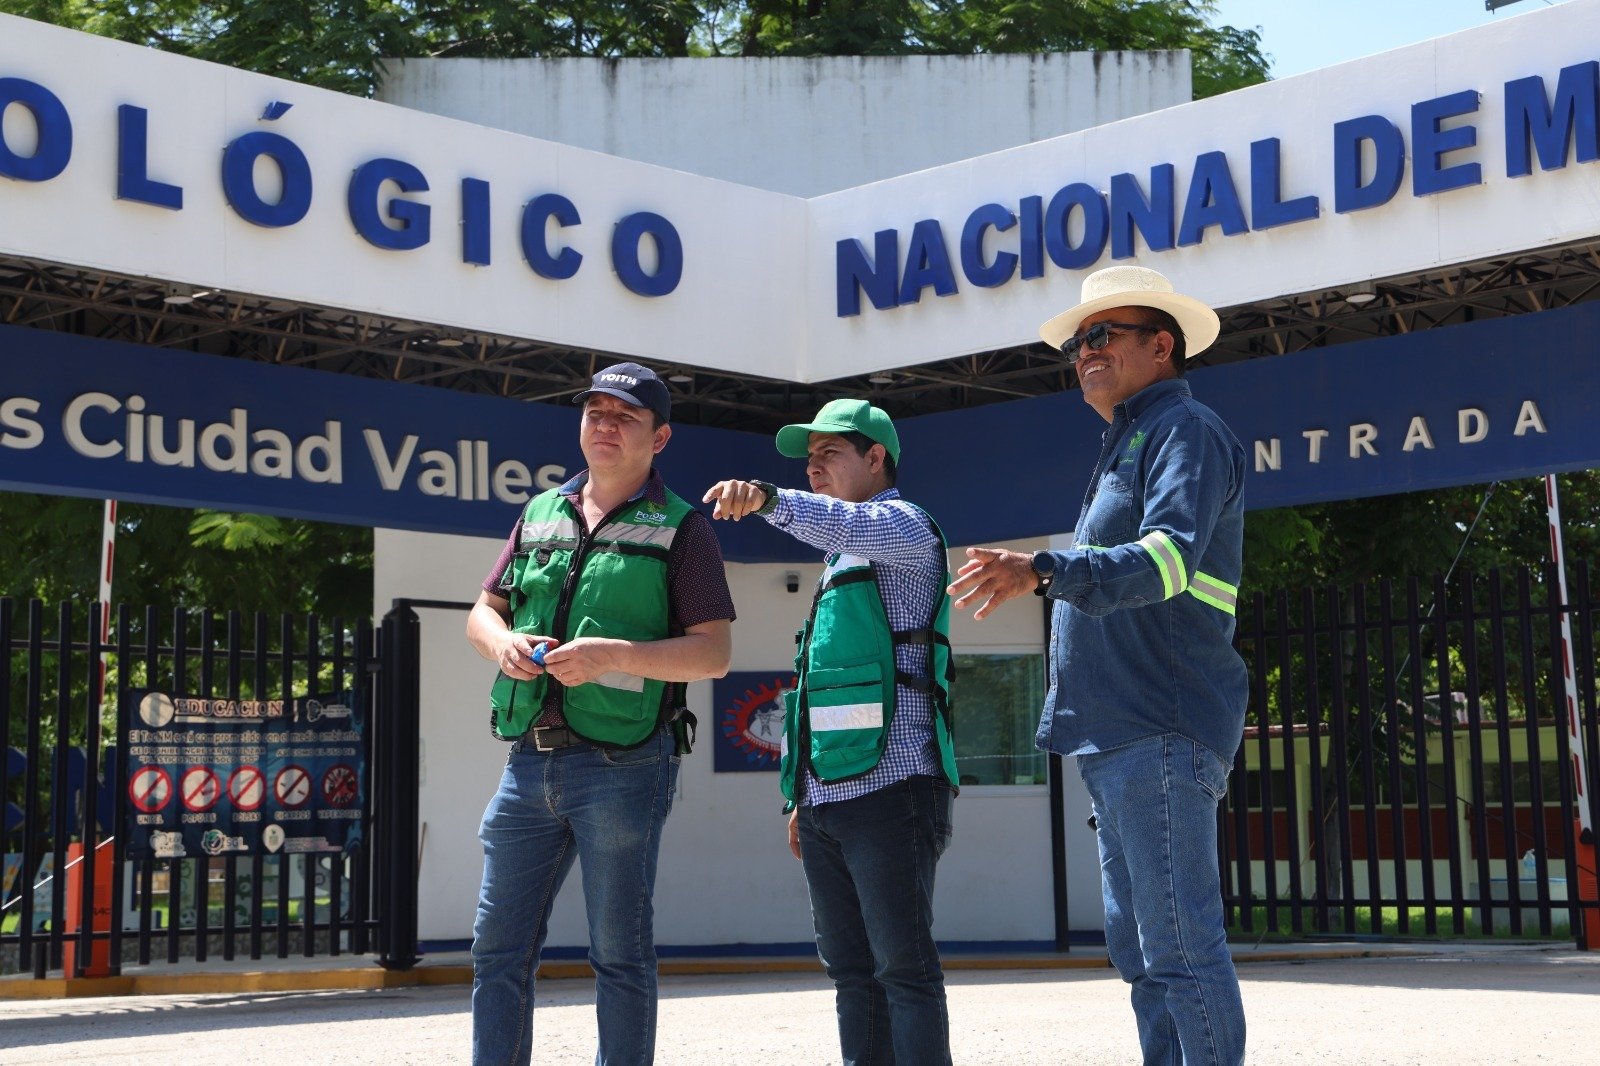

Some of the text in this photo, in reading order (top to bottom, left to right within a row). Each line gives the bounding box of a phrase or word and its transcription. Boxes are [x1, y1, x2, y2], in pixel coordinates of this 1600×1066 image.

[0, 77, 684, 297] OLÓGICO
[836, 60, 1600, 318] NACIONAL DE M
[601, 373, 638, 386] VOITH
[1254, 400, 1548, 472] NTRADA
[62, 391, 343, 484] Ciudad
[363, 429, 567, 507] Valles
